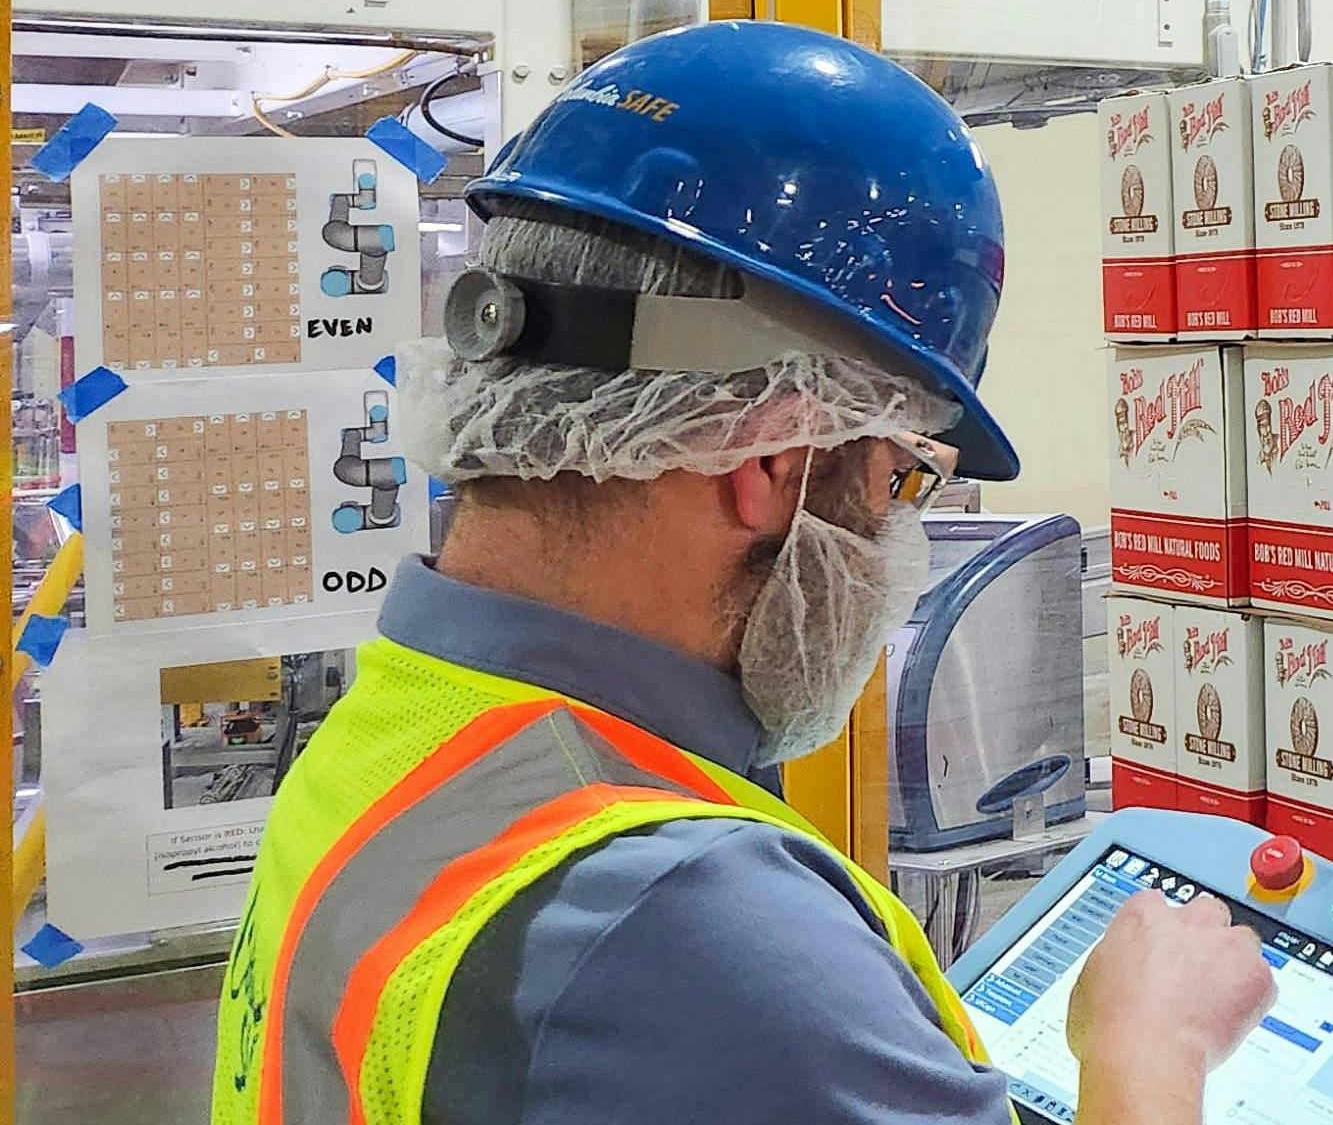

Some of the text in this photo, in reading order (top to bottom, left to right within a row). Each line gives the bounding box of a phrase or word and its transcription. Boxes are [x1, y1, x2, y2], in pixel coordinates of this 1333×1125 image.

[616, 90, 680, 122] SAFE
[307, 317, 373, 339] EVEN
[1254, 544, 1277, 565] BOB'S
[1277, 545, 1294, 567] RED
[1295, 547, 1313, 569] MILL
[323, 568, 387, 592] ODD
